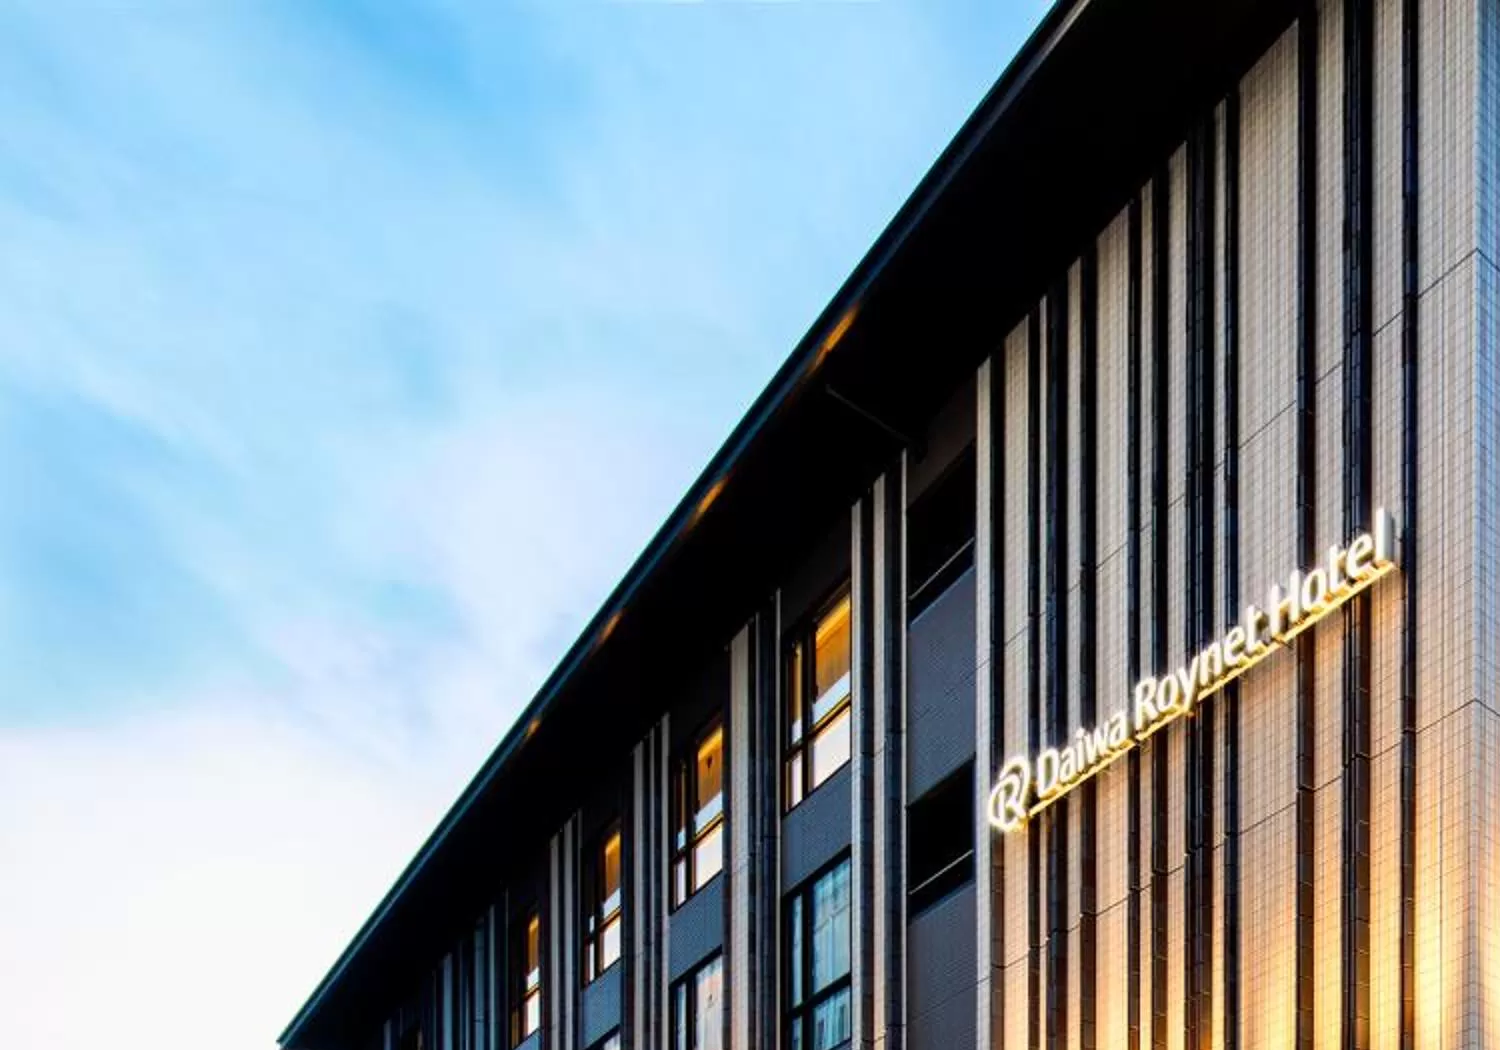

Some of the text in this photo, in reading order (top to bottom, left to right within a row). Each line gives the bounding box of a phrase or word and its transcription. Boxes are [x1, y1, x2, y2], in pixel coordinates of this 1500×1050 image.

[1036, 710, 1127, 798] Daiwa
[1135, 605, 1263, 730] Roynet
[1270, 507, 1387, 637] Hotel
